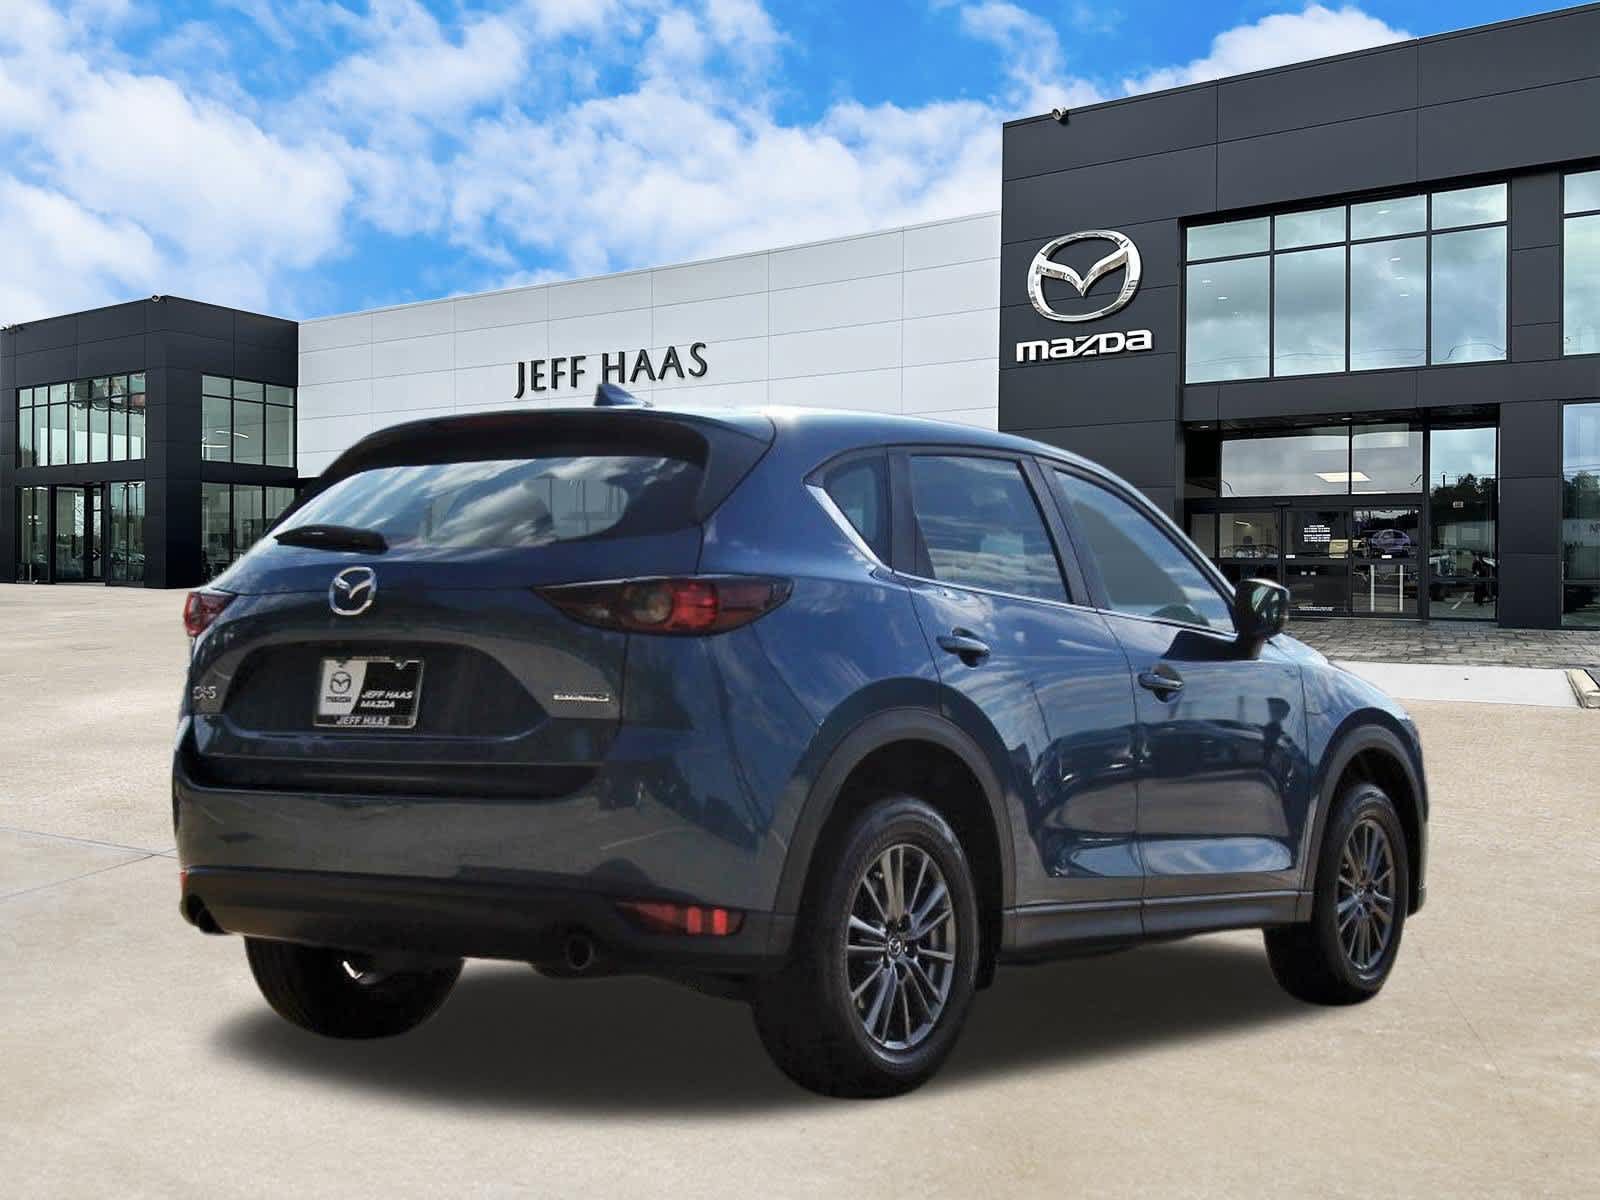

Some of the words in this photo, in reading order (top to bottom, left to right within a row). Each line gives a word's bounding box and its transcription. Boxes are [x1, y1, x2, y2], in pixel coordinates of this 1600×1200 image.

[514, 355, 586, 399] JEFF
[602, 342, 708, 384] HAAS
[361, 690, 385, 699] JEFF
[385, 690, 413, 699] HAAS
[360, 700, 395, 708] MAZDA
[336, 716, 362, 725] JEFF
[362, 715, 391, 726] HAAS
